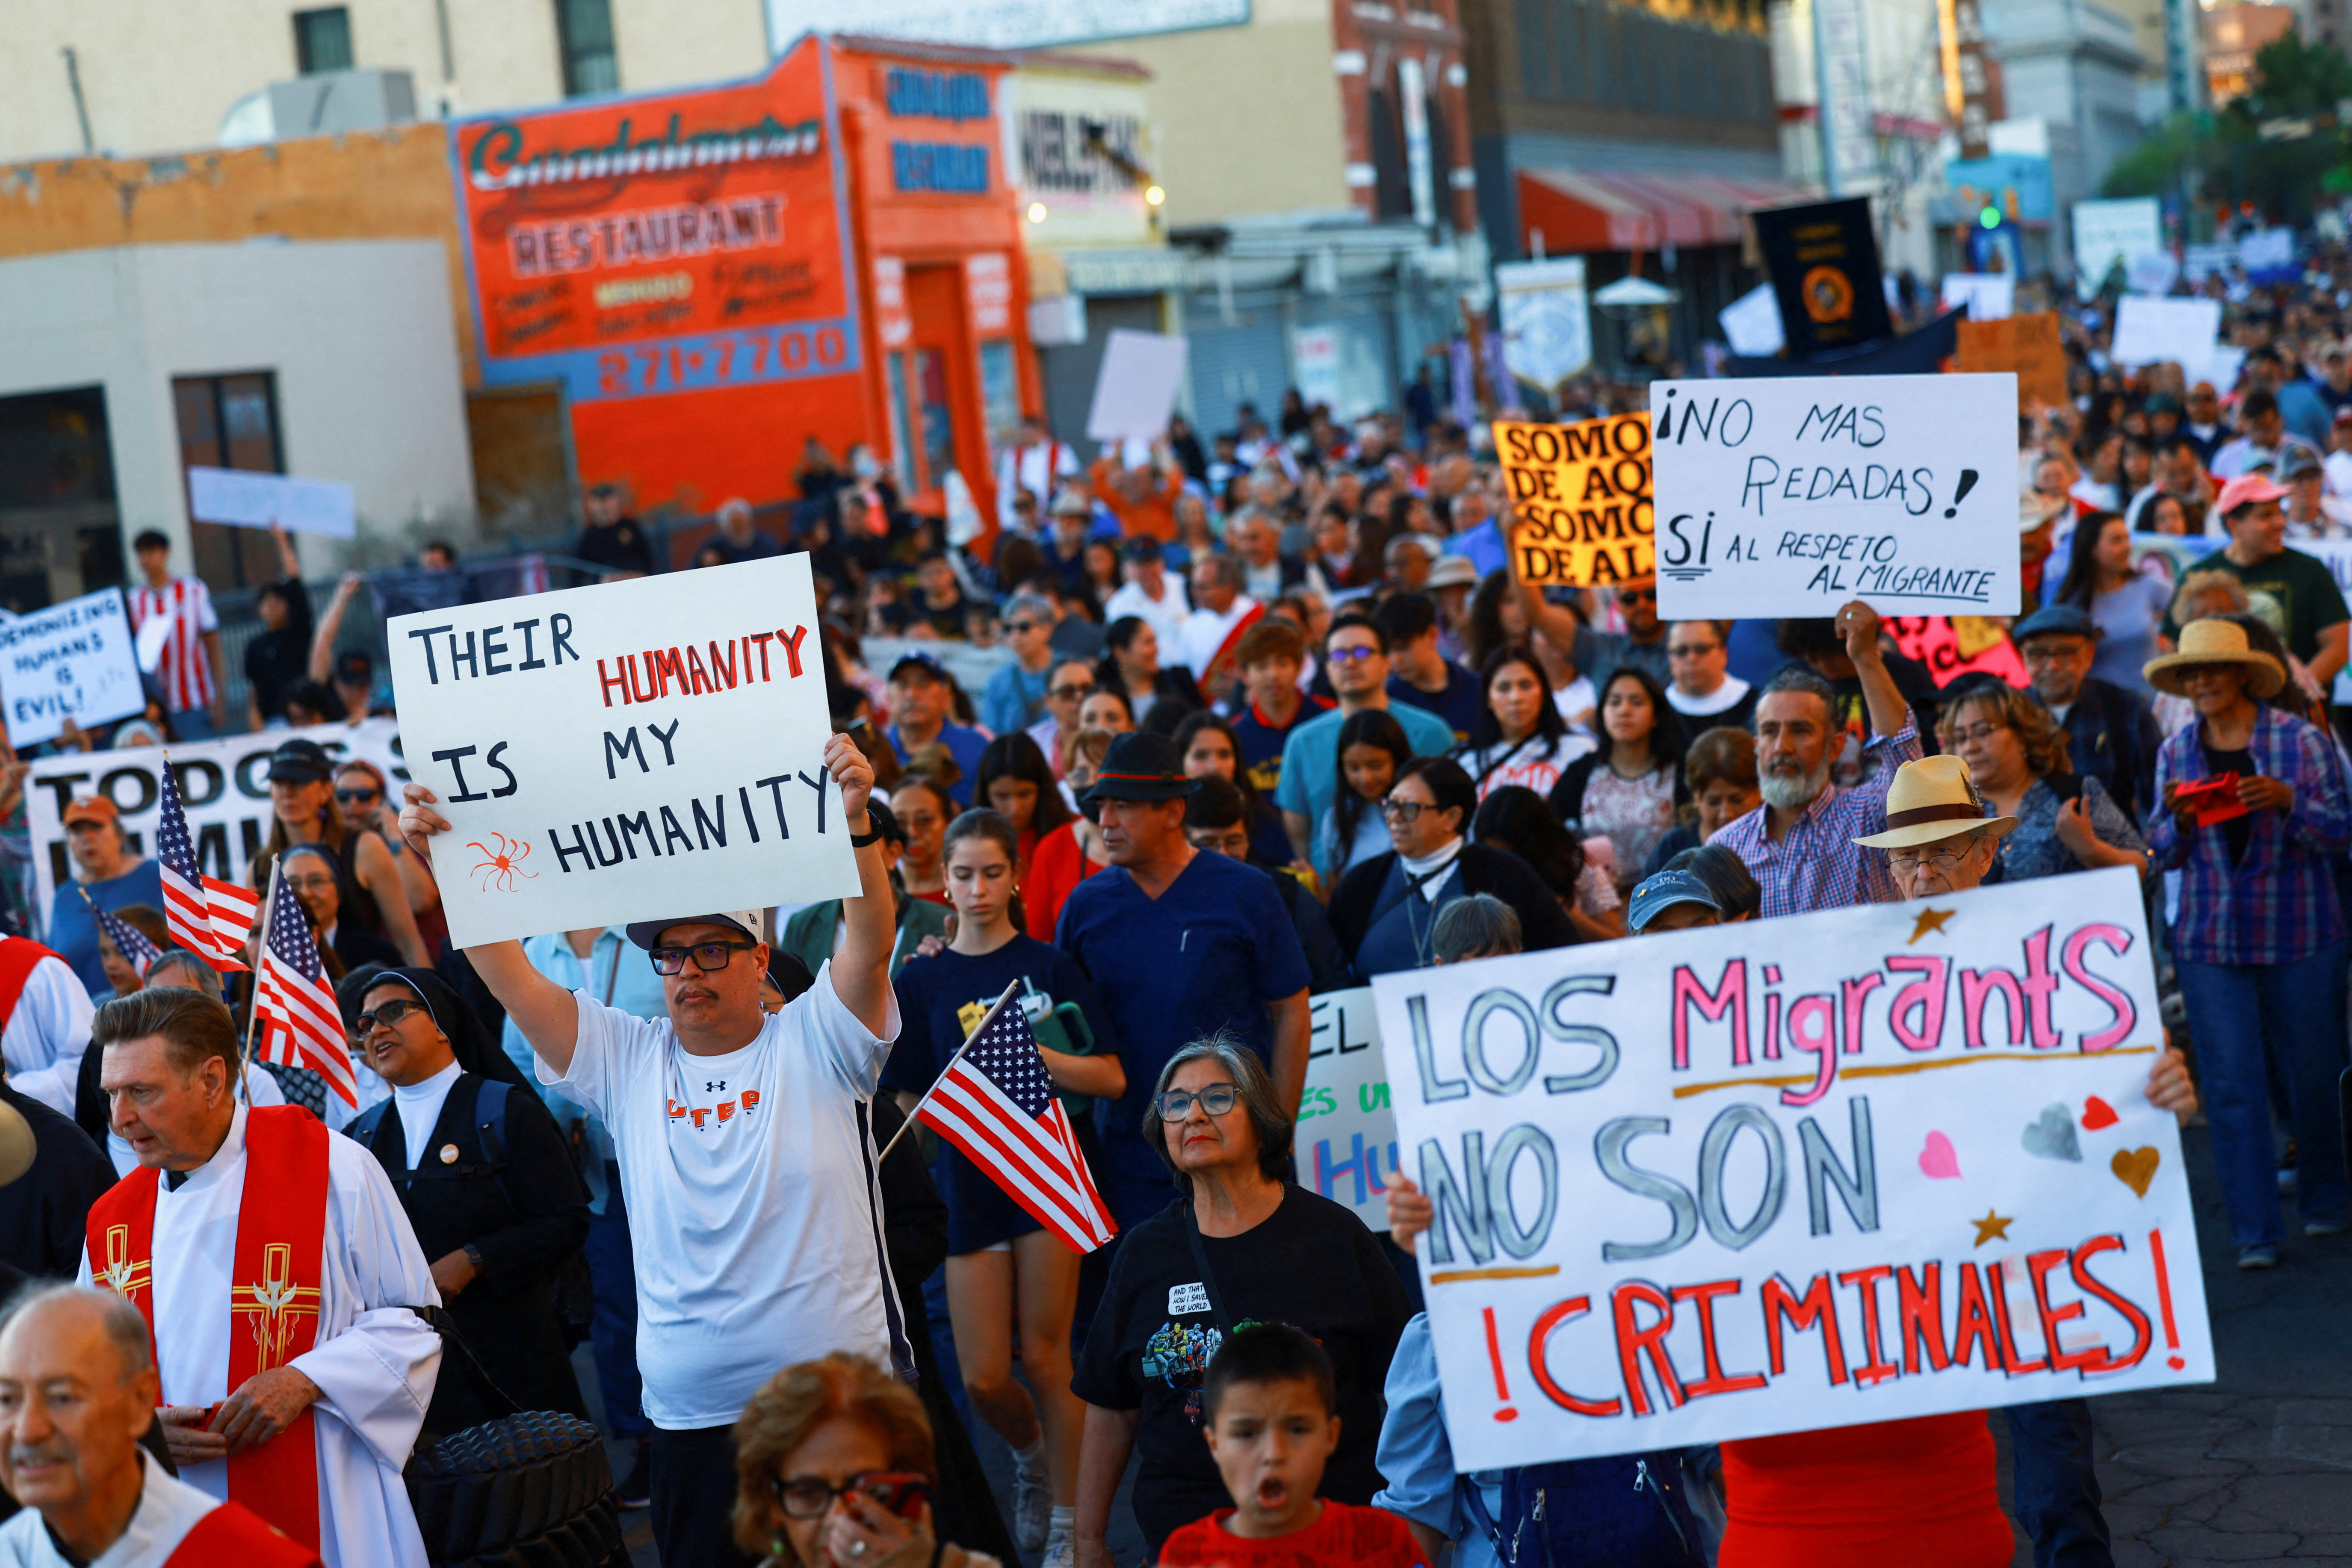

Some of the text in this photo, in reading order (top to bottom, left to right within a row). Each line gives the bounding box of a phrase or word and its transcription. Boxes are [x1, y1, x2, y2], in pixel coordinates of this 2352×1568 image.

[507, 191, 789, 280] RESTAURANT
[1656, 388, 1885, 447] ¡NO MAS
[1510, 457, 1653, 501] DE AQ
[1523, 546, 1578, 579] DE
[1726, 534, 1759, 562] AL
[1776, 531, 1898, 563] RESPETO
[1807, 564, 1996, 596] AL MIGRANTE
[15, 629, 103, 672] HUMANS
[408, 613, 580, 685] THEIR
[596, 624, 808, 708] HUMANITY
[16, 684, 83, 724] EVIL!
[431, 741, 518, 803] IS
[603, 718, 680, 779] MY
[35, 742, 349, 823] TODO
[547, 765, 829, 874] HUMANITY
[1650, 881, 1687, 892] SOMETHING
[1406, 974, 1620, 1104] LOS
[1418, 1095, 1880, 1265] NO SON
[1173, 1296, 1186, 1304] HOW
[1174, 1287, 1186, 1296] AND
[1187, 1302, 1207, 1311] WORLD
